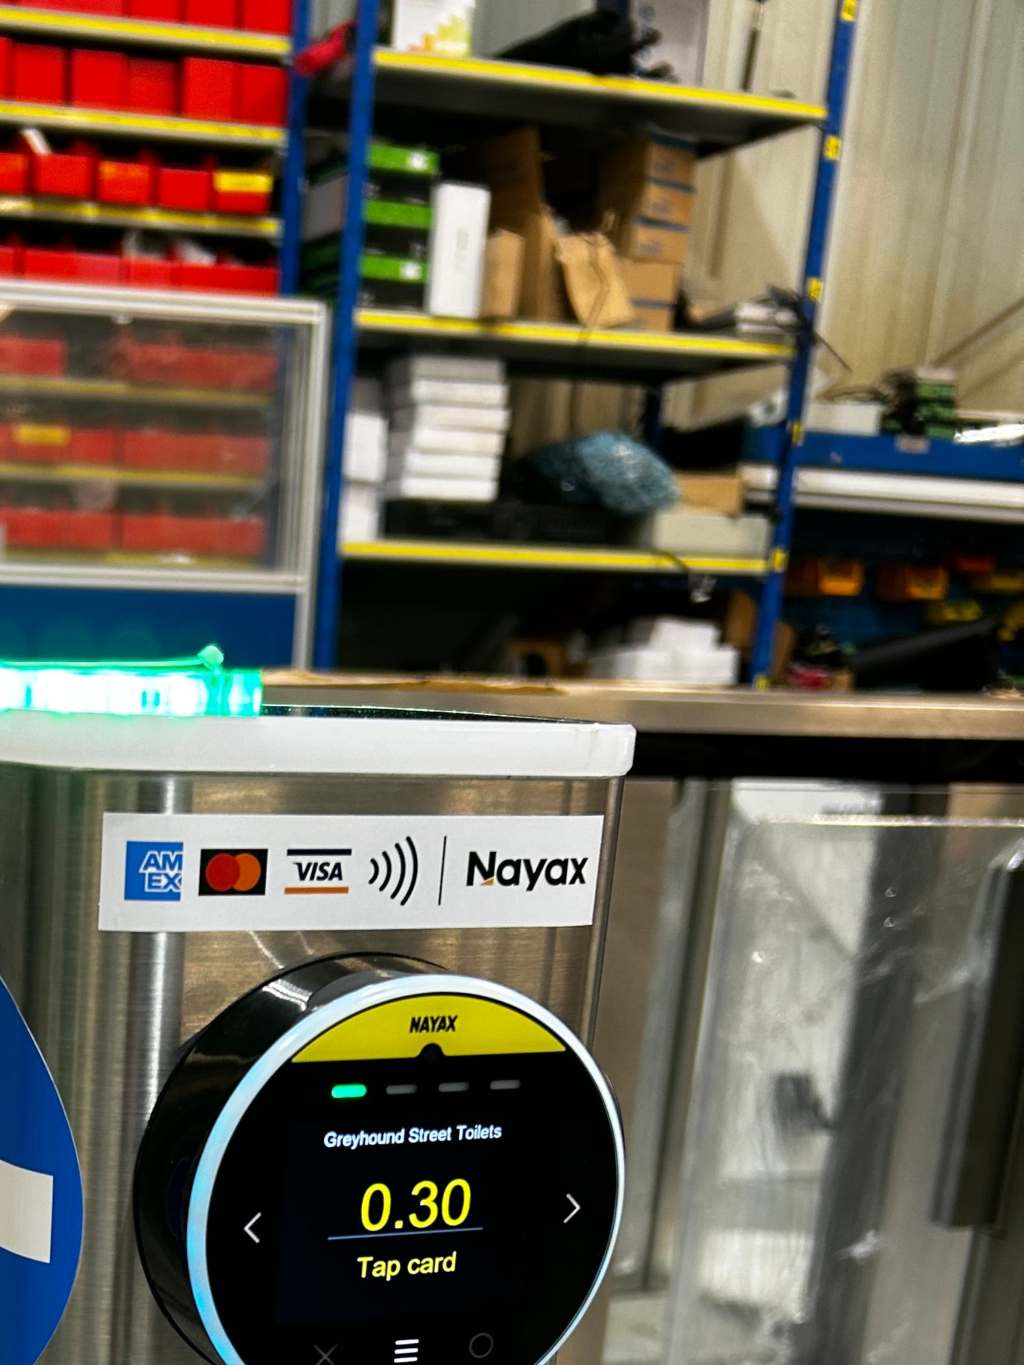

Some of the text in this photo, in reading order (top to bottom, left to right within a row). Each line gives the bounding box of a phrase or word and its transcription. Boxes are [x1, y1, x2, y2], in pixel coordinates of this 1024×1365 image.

[293, 862, 343, 881] VISA
[466, 851, 589, 892] Nayax
[409, 1014, 458, 1034] NAYAX
[323, 1124, 503, 1150] Greyhound Street Toilets
[361, 1178, 472, 1232] 0.30
[356, 1250, 457, 1281] Tap card
